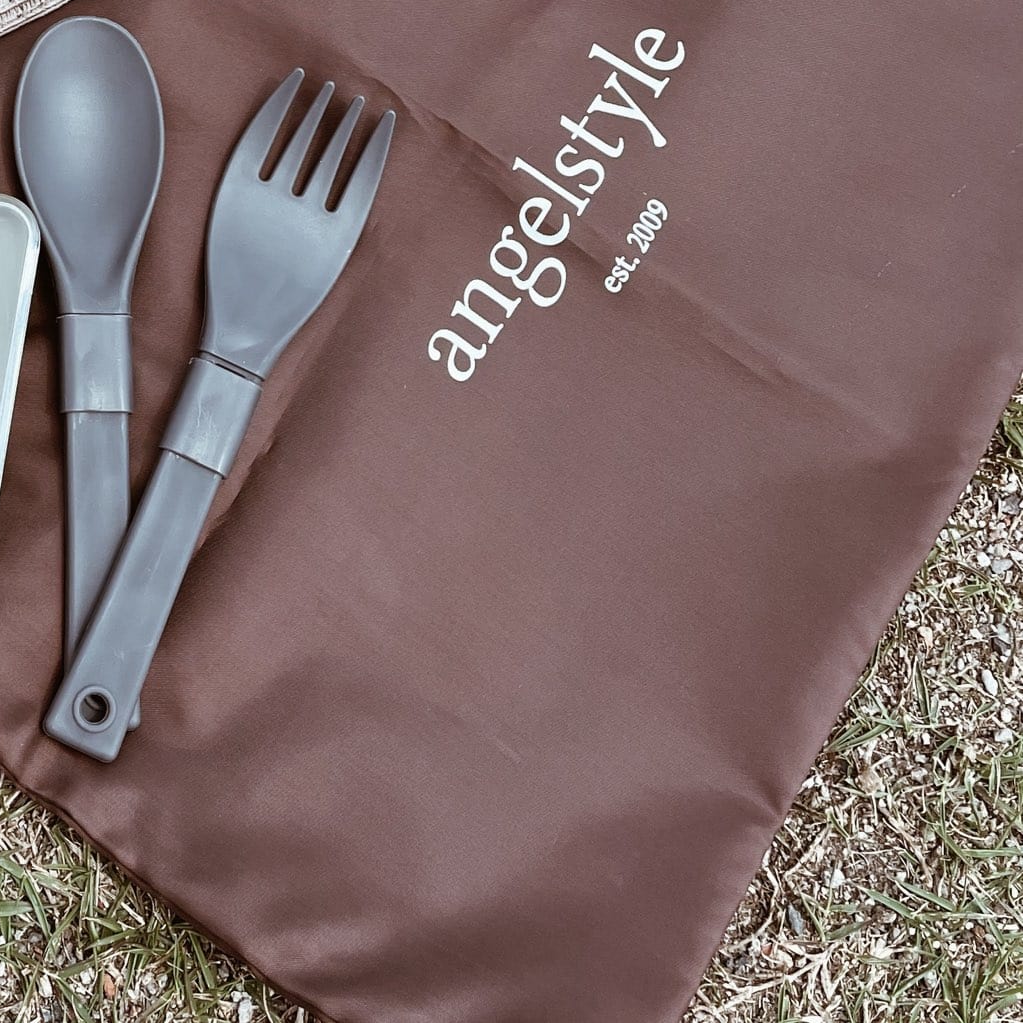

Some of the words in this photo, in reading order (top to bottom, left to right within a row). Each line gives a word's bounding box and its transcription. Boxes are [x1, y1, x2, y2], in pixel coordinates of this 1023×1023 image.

[428, 28, 685, 382] angelstyle
[603, 254, 641, 294] est.
[627, 198, 669, 254] 2009
